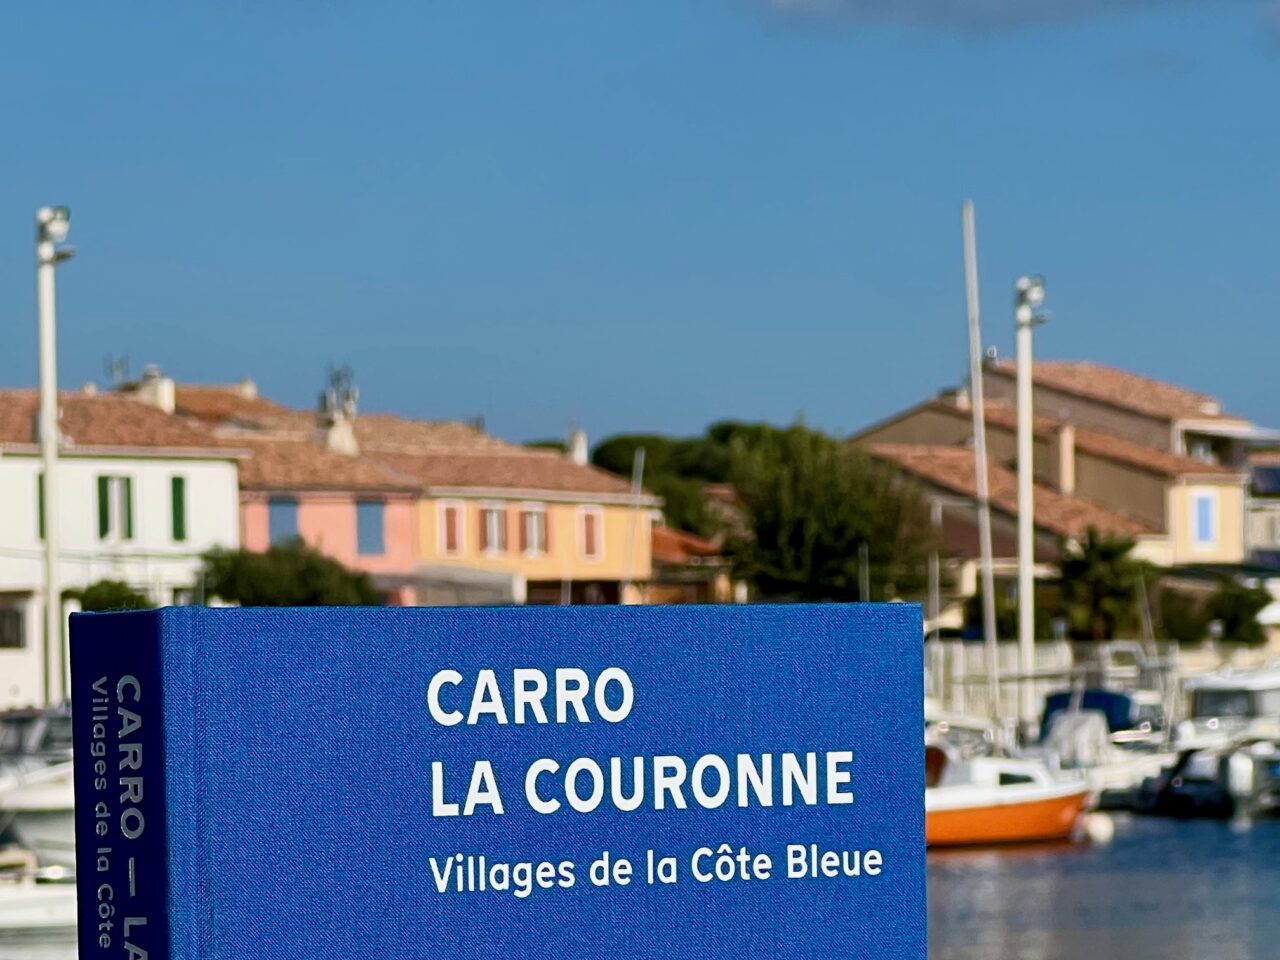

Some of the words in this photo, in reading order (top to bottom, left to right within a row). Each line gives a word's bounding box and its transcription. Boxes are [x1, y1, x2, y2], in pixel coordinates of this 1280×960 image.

[427, 667, 634, 727] CARRO
[90, 676, 109, 791] Villages
[116, 674, 145, 840] CARRO
[431, 760, 505, 817] LA
[524, 751, 854, 814] COURONNE
[94, 801, 111, 837] de
[97, 847, 112, 872] la
[428, 852, 576, 898] Villages
[589, 850, 633, 887] de
[647, 849, 677, 885] la
[691, 843, 773, 883] Côte
[786, 843, 883, 879] Bleue
[98, 883, 116, 949] Côte
